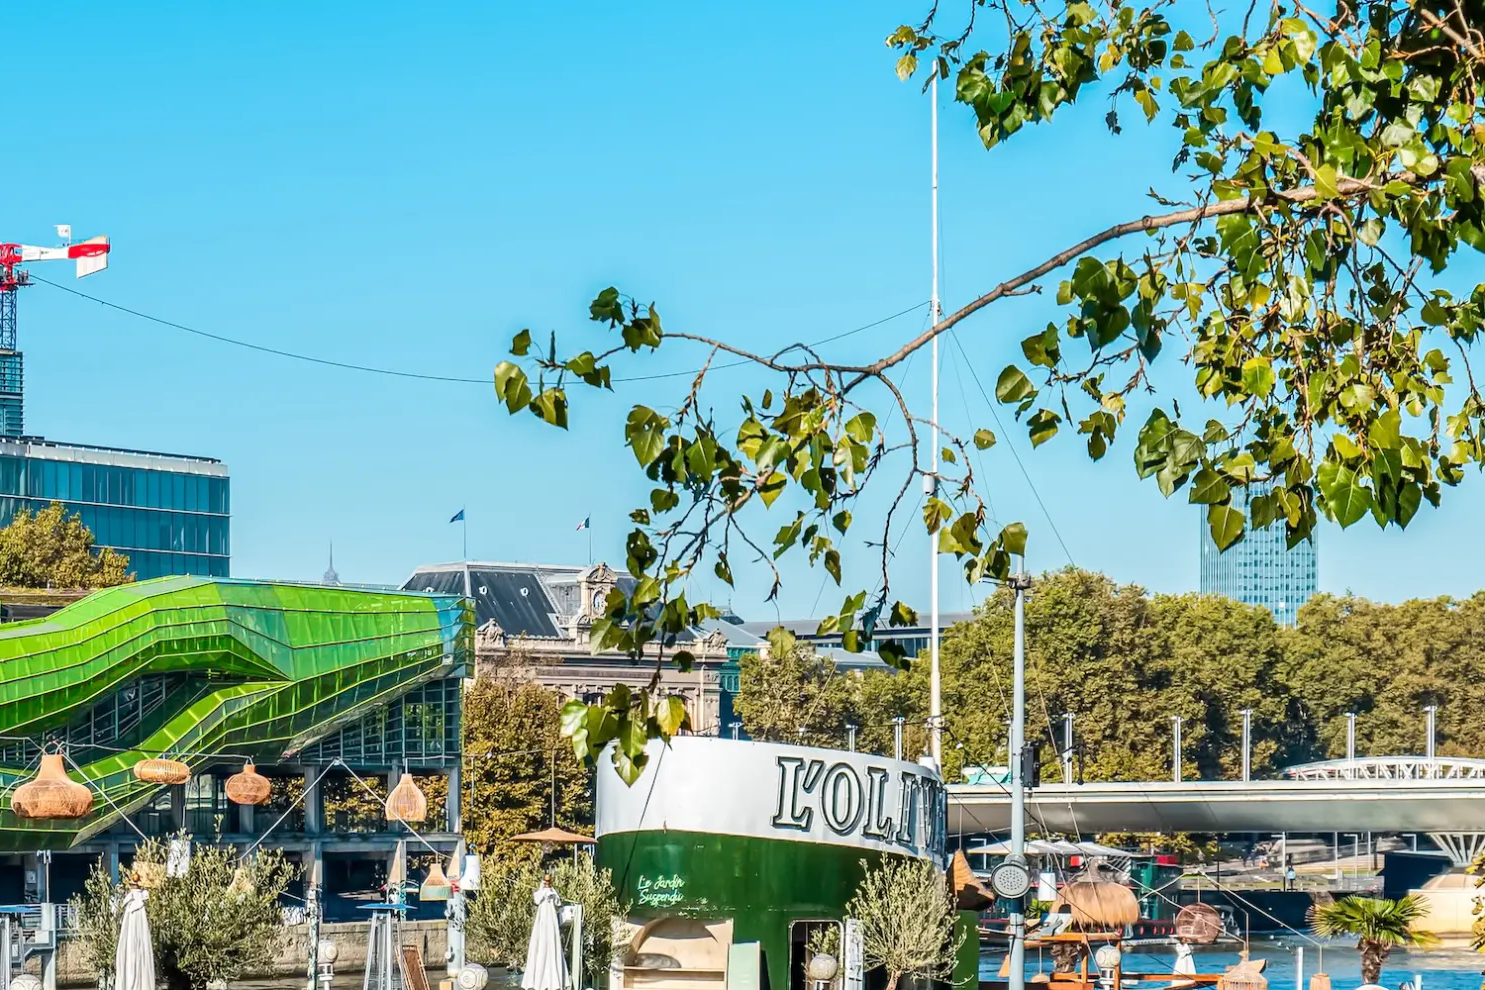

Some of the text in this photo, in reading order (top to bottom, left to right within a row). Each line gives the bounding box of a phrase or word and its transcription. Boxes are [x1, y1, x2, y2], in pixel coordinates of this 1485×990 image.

[637, 874, 685, 890] Le Jardin
[638, 888, 684, 907] Suspendu
